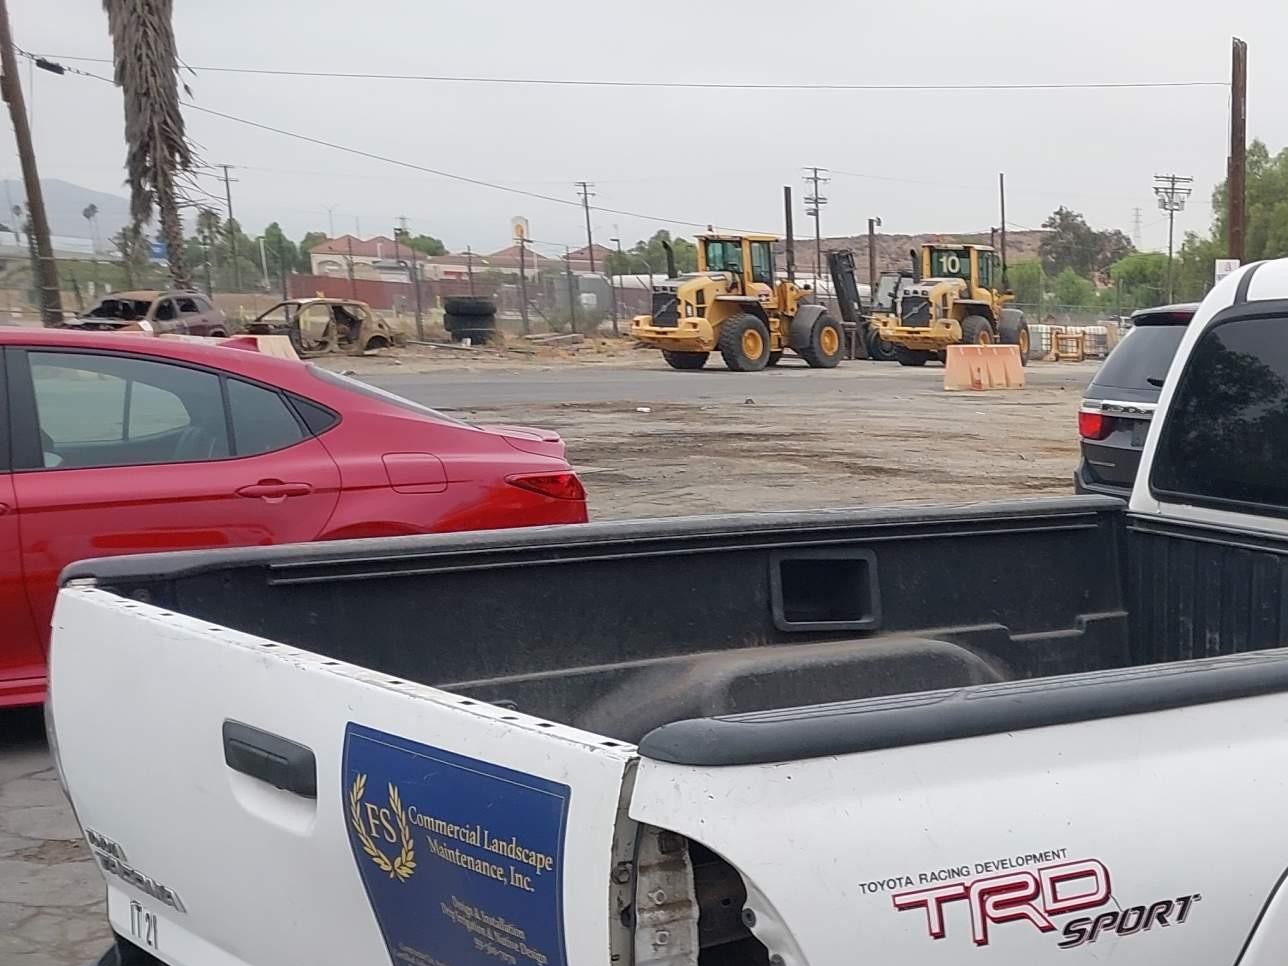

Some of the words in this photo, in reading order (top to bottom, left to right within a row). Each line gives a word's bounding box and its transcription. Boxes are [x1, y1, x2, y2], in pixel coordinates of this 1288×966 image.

[939, 255, 960, 273] 10
[408, 806, 481, 847] Commercial
[484, 830, 553, 875] Landscape
[426, 835, 508, 885] Maintenance,
[510, 866, 535, 893] Inc.
[859, 876, 914, 894] TOYOTA
[919, 865, 970, 884] RACING
[975, 848, 1068, 874] DEVELOPMENT
[892, 858, 1112, 946] TRD
[1057, 894, 1200, 949] SPORT
